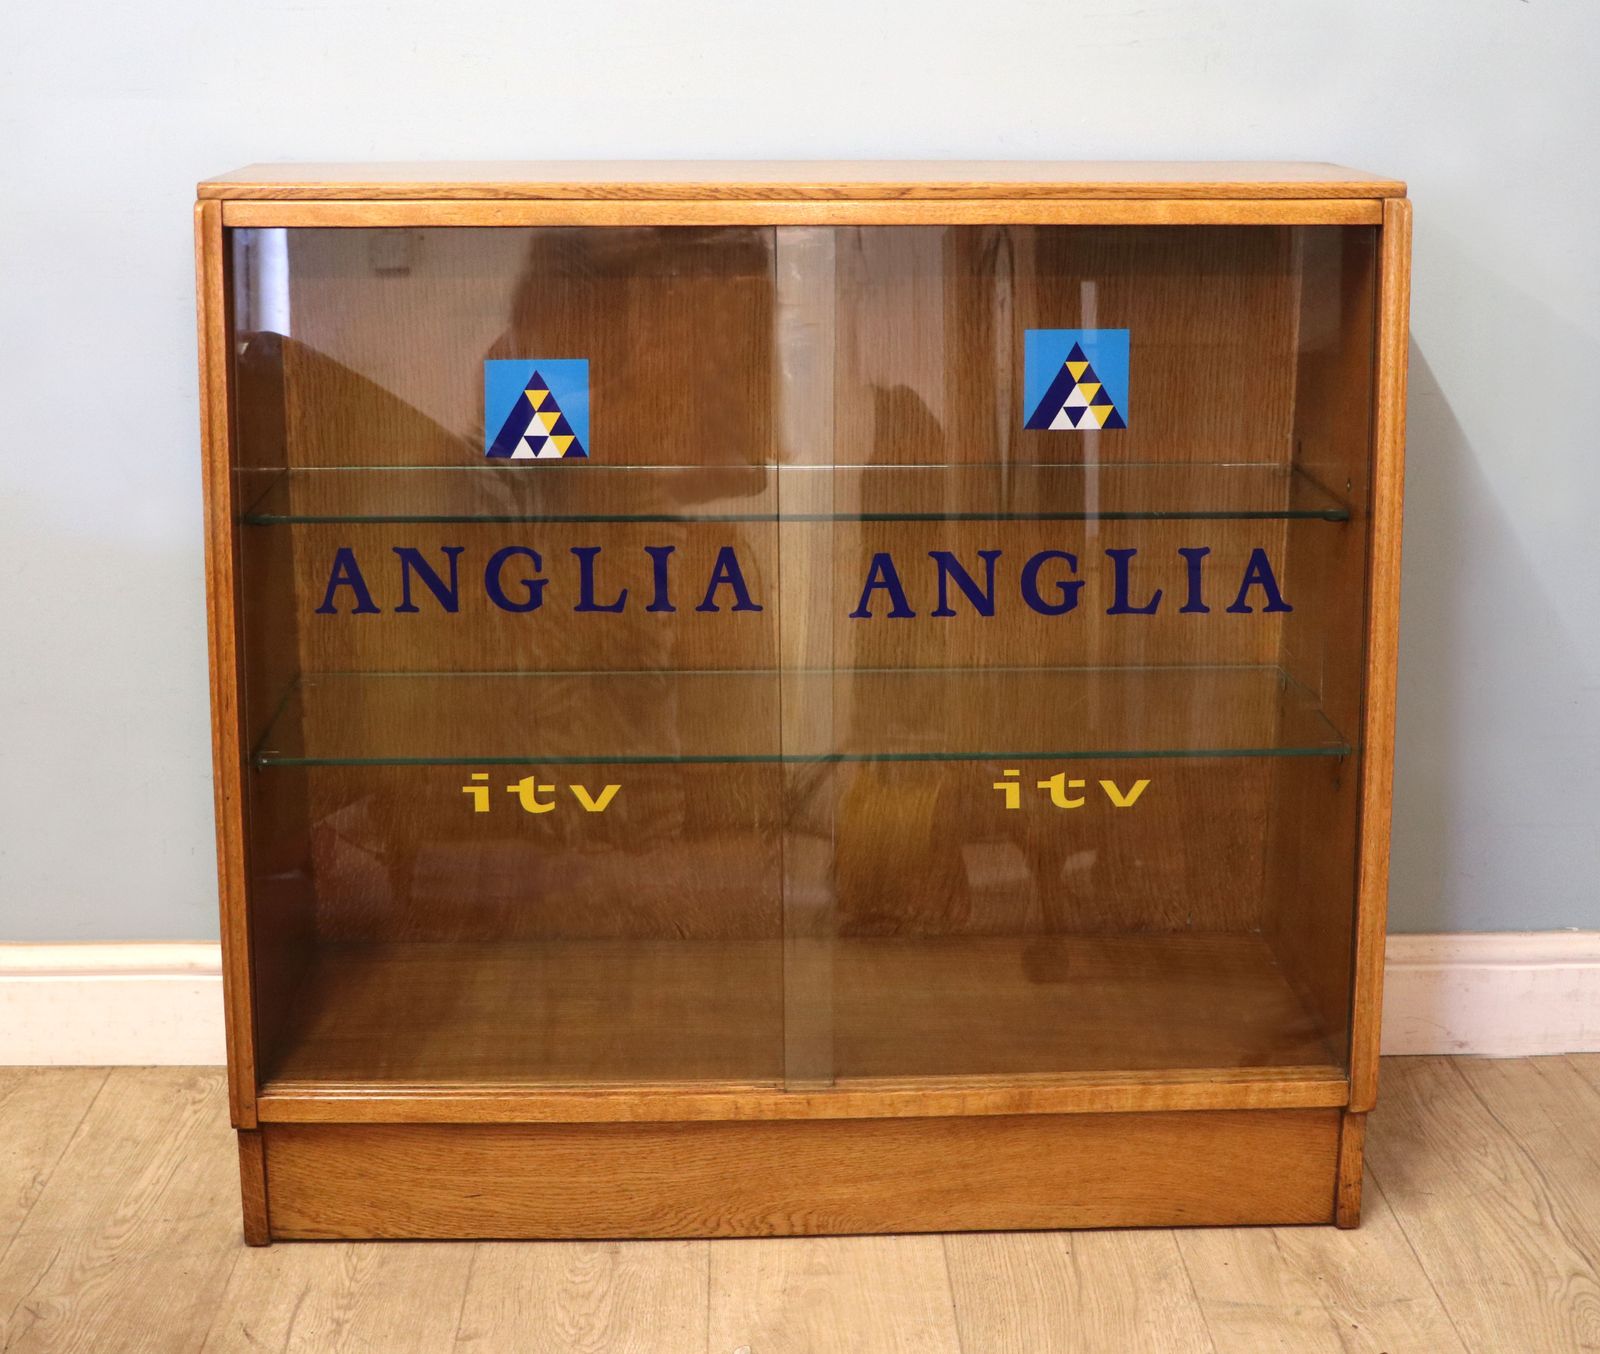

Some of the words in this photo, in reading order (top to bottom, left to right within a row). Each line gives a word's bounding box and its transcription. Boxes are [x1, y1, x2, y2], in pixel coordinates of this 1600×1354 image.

[315, 545, 763, 615] ANGLIA
[849, 547, 1293, 619] ANGLIA
[462, 772, 622, 814] itv
[993, 768, 1151, 810] itv
